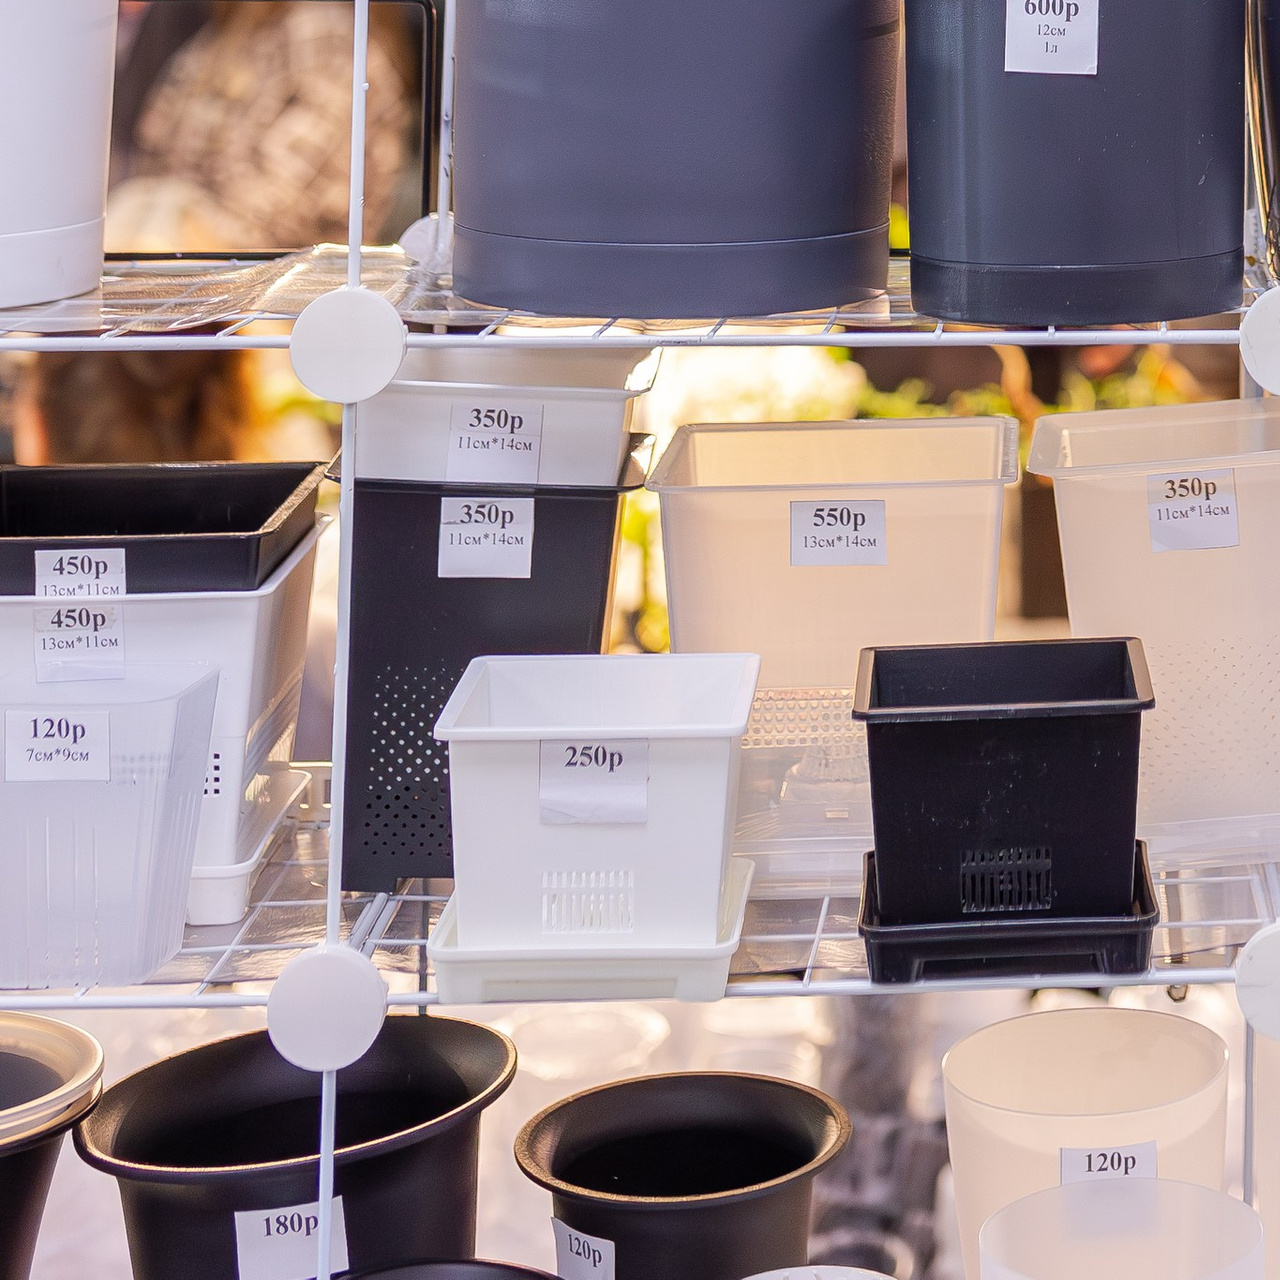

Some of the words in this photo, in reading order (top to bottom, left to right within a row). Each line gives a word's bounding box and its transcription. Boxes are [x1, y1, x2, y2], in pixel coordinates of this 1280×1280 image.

[1037, 23, 1067, 37] 12см
[1045, 41, 1059, 54] 1л
[468, 407, 524, 435] 350р
[1164, 476, 1217, 501] 350р
[459, 503, 515, 530] 350р
[812, 506, 866, 532] 550р
[52, 554, 109, 580] 450р
[50, 607, 107, 633] 450р
[29, 717, 87, 745] 120р
[564, 744, 624, 774] 250р
[1084, 1151, 1137, 1177] 120р
[262, 1211, 320, 1237] 180р
[568, 1233, 603, 1269] 120р
